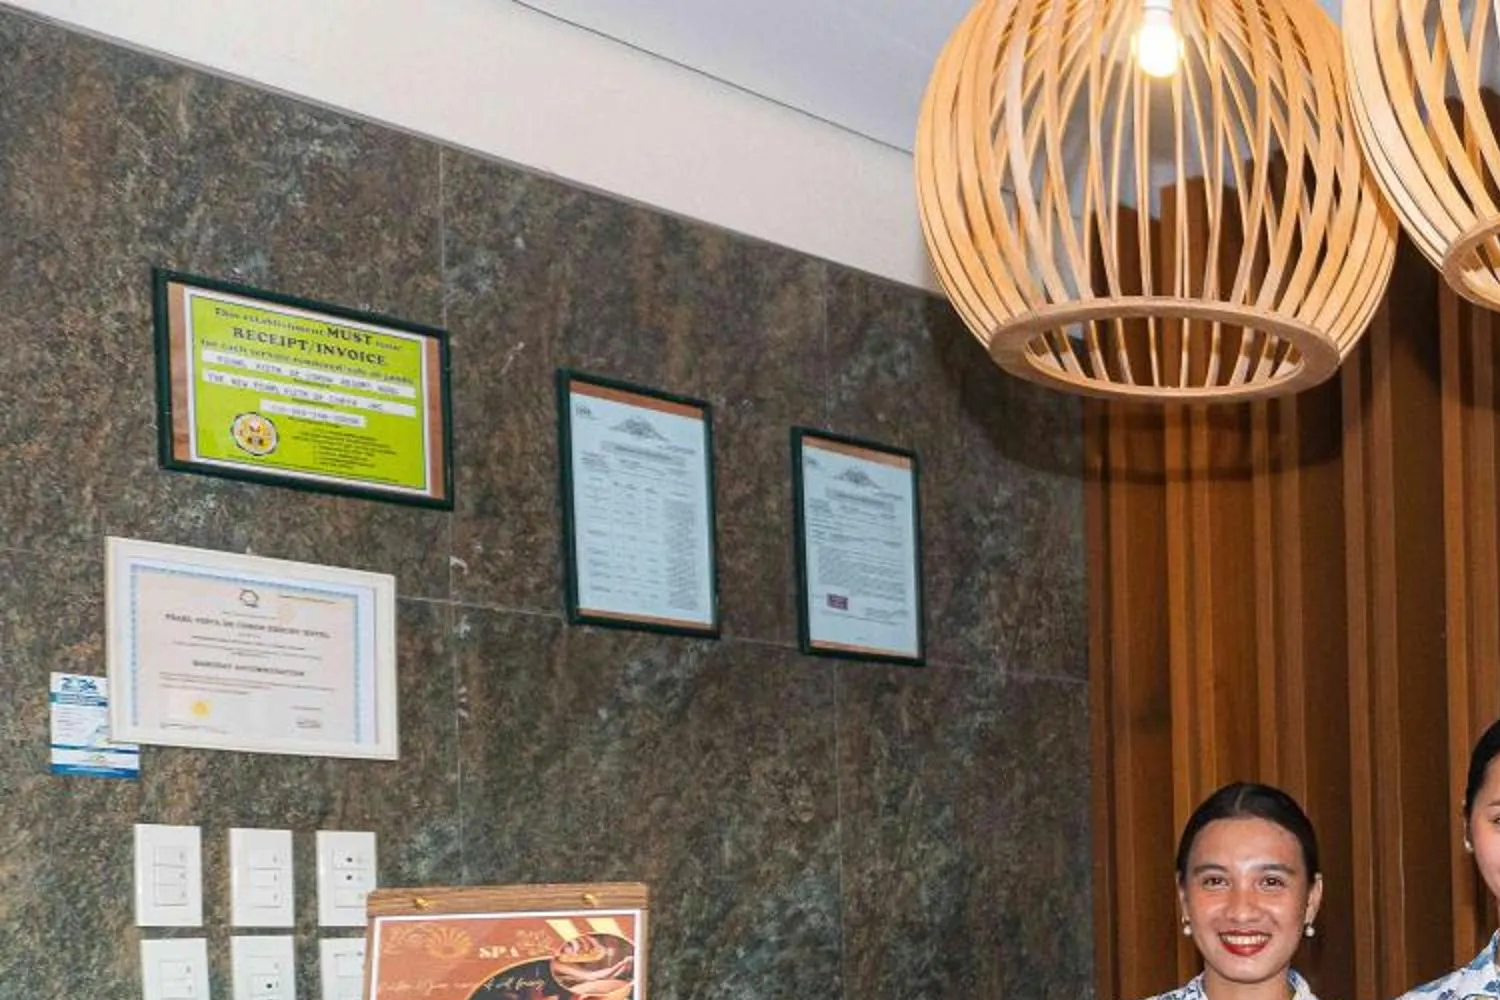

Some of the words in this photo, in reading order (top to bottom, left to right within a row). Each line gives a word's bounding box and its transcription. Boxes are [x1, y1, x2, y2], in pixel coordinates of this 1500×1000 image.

[232, 326, 386, 365] RECEIPT/INVOICE
[326, 327, 372, 346] MUST
[479, 945, 520, 959] SPA
